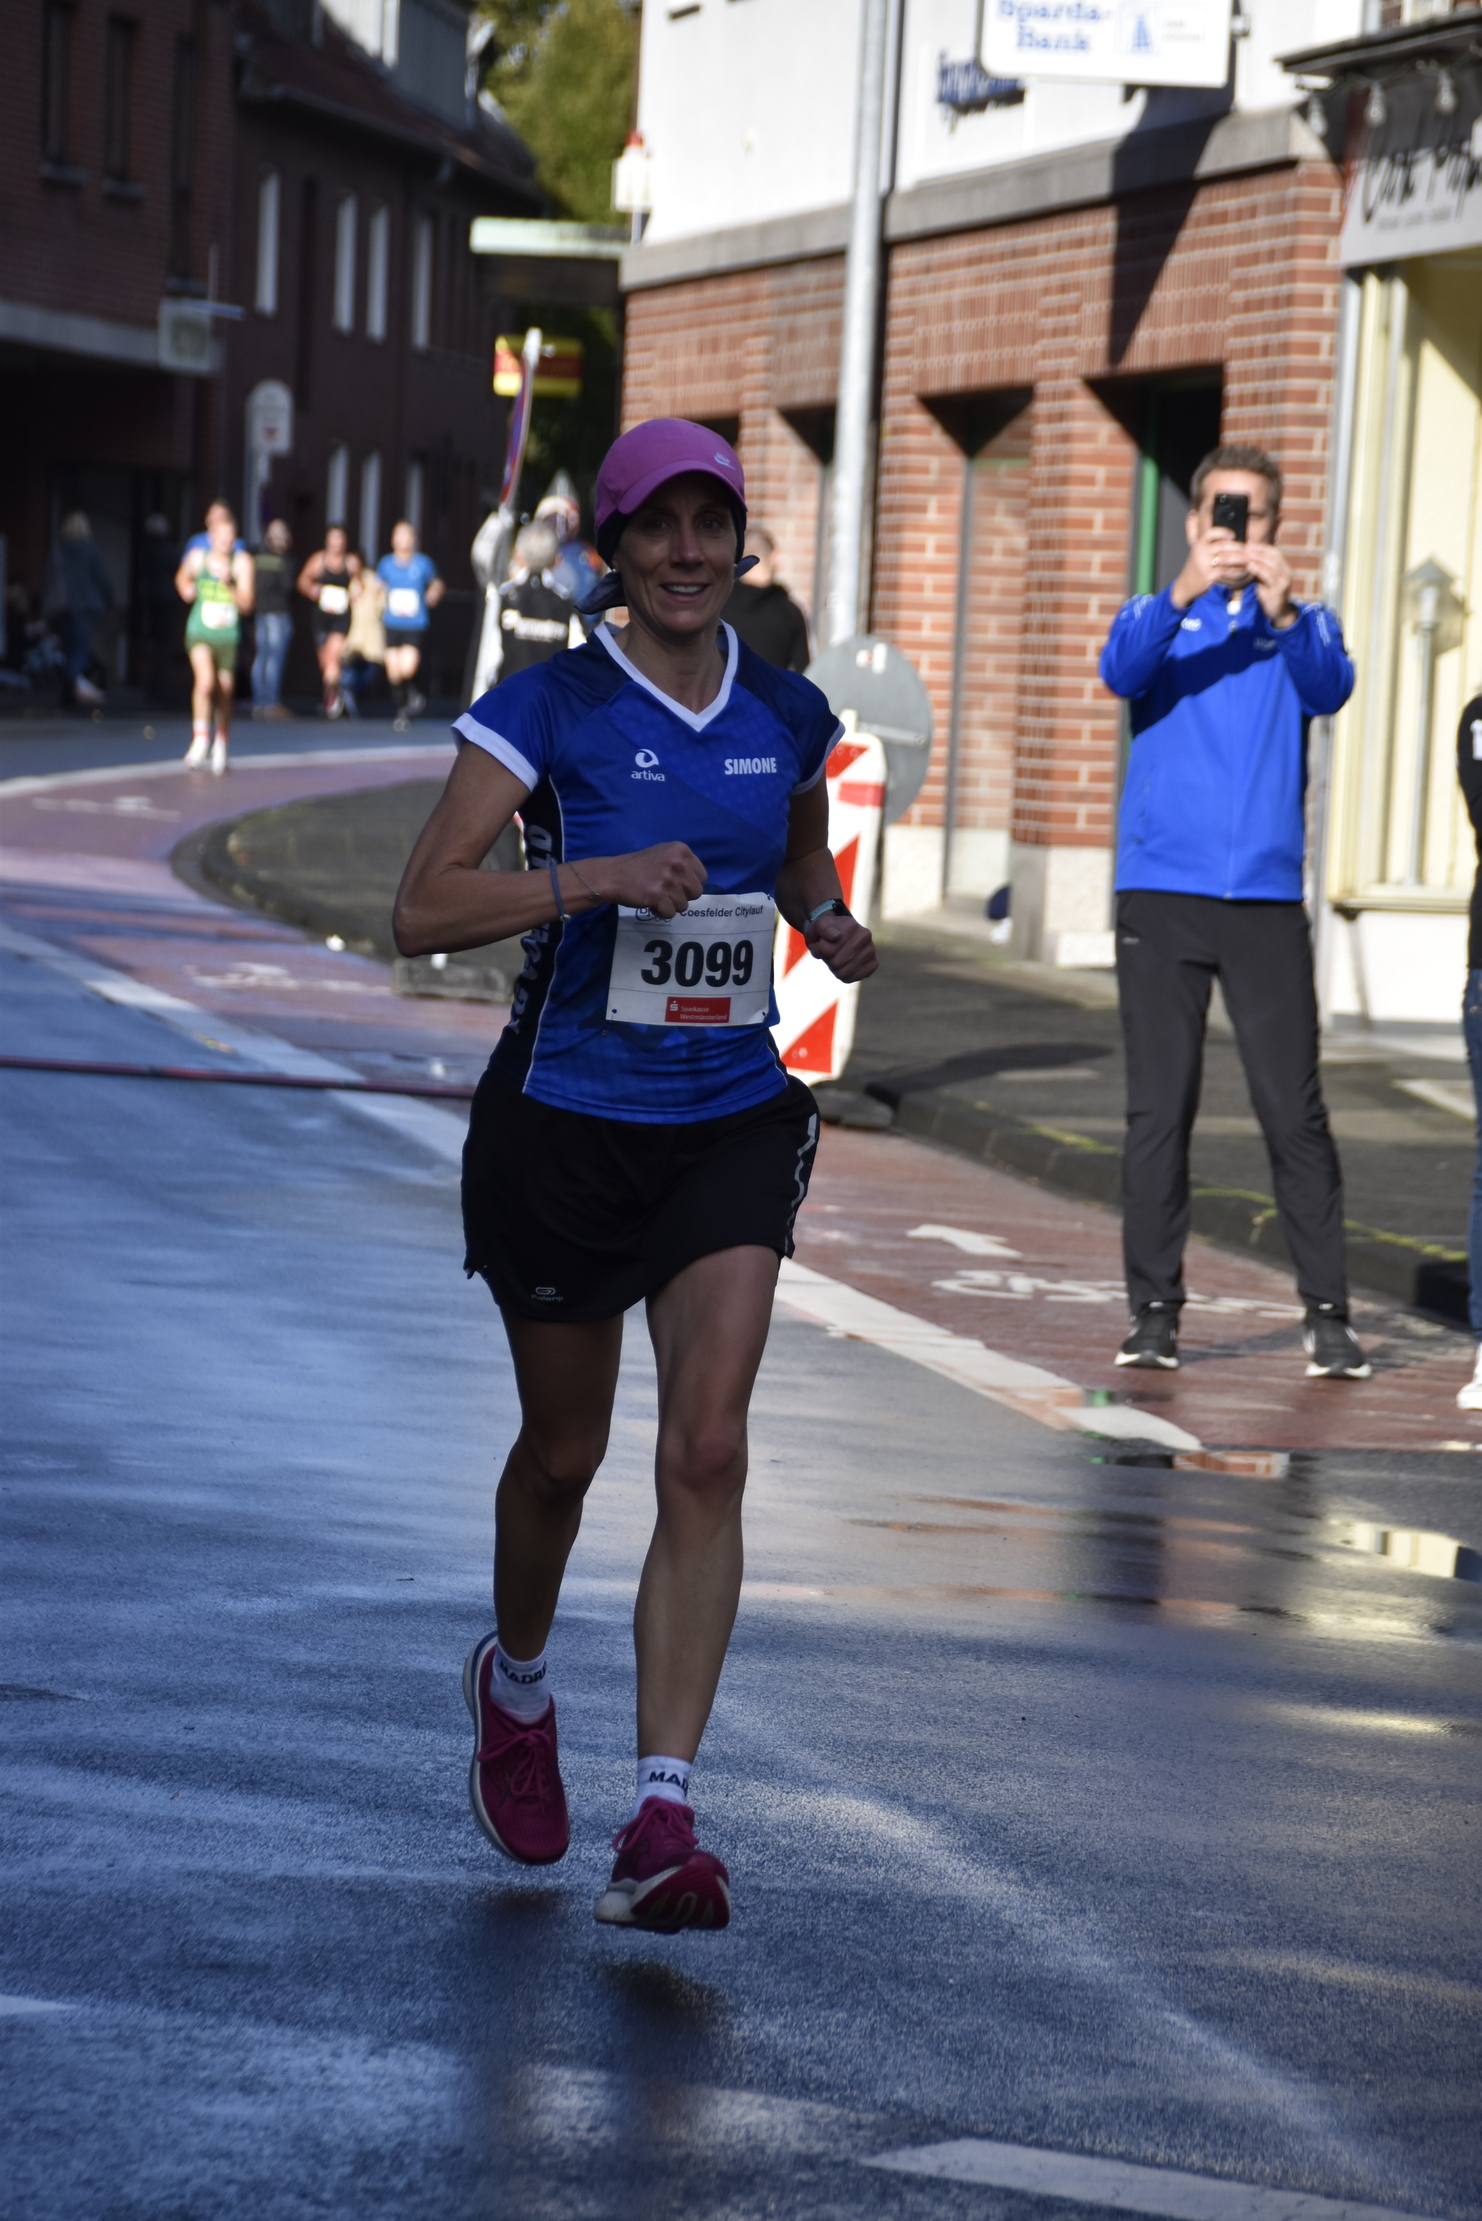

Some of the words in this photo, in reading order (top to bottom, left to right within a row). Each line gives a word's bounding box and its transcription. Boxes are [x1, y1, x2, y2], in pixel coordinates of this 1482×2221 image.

[724, 757, 777, 775] SIMONE
[631, 769, 666, 782] artiva
[735, 905, 763, 918] Citylauf
[641, 939, 754, 987] 3099
